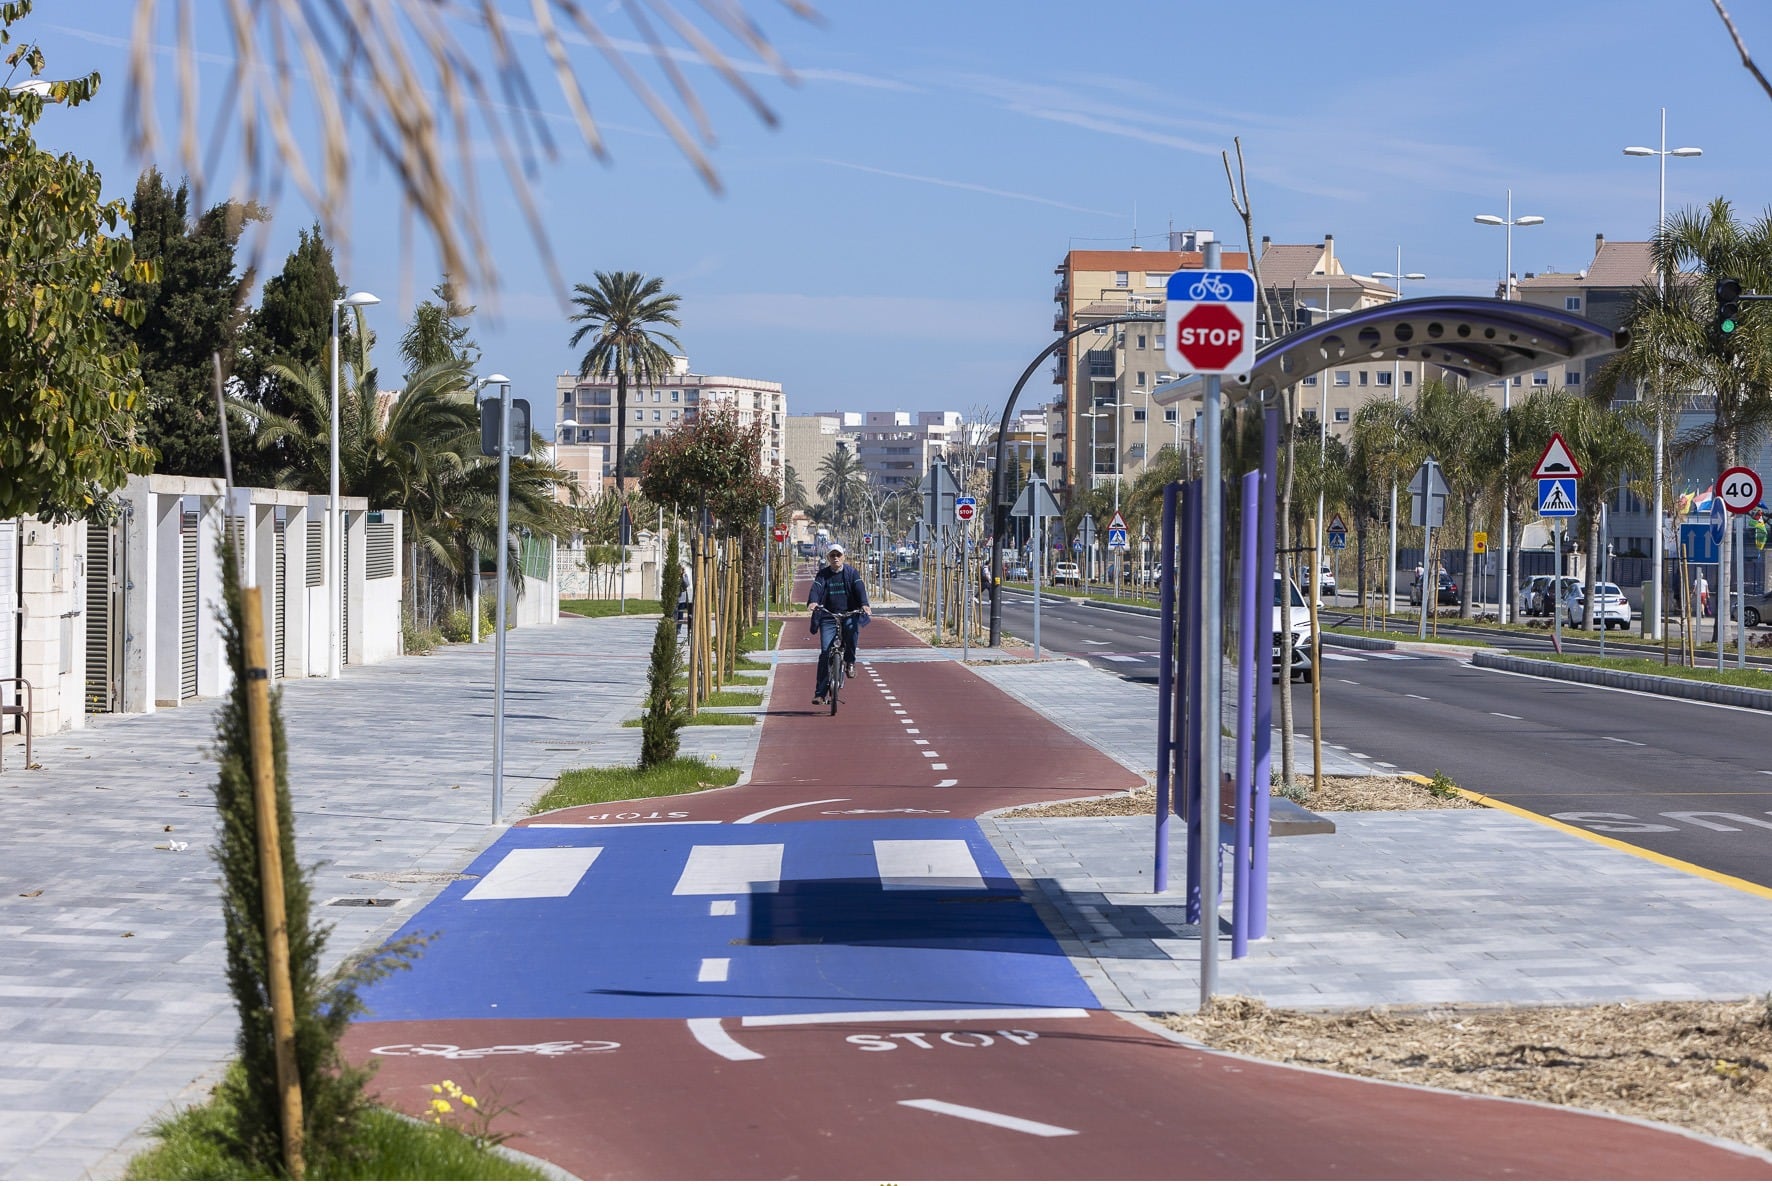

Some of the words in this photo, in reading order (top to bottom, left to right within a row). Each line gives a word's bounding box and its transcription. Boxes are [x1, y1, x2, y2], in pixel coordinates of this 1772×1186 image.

[1181, 327, 1241, 346] STOP
[1725, 482, 1754, 498] 40
[587, 811, 690, 820] STOP
[1549, 810, 1772, 832] US
[845, 1029, 1039, 1051] STOP
